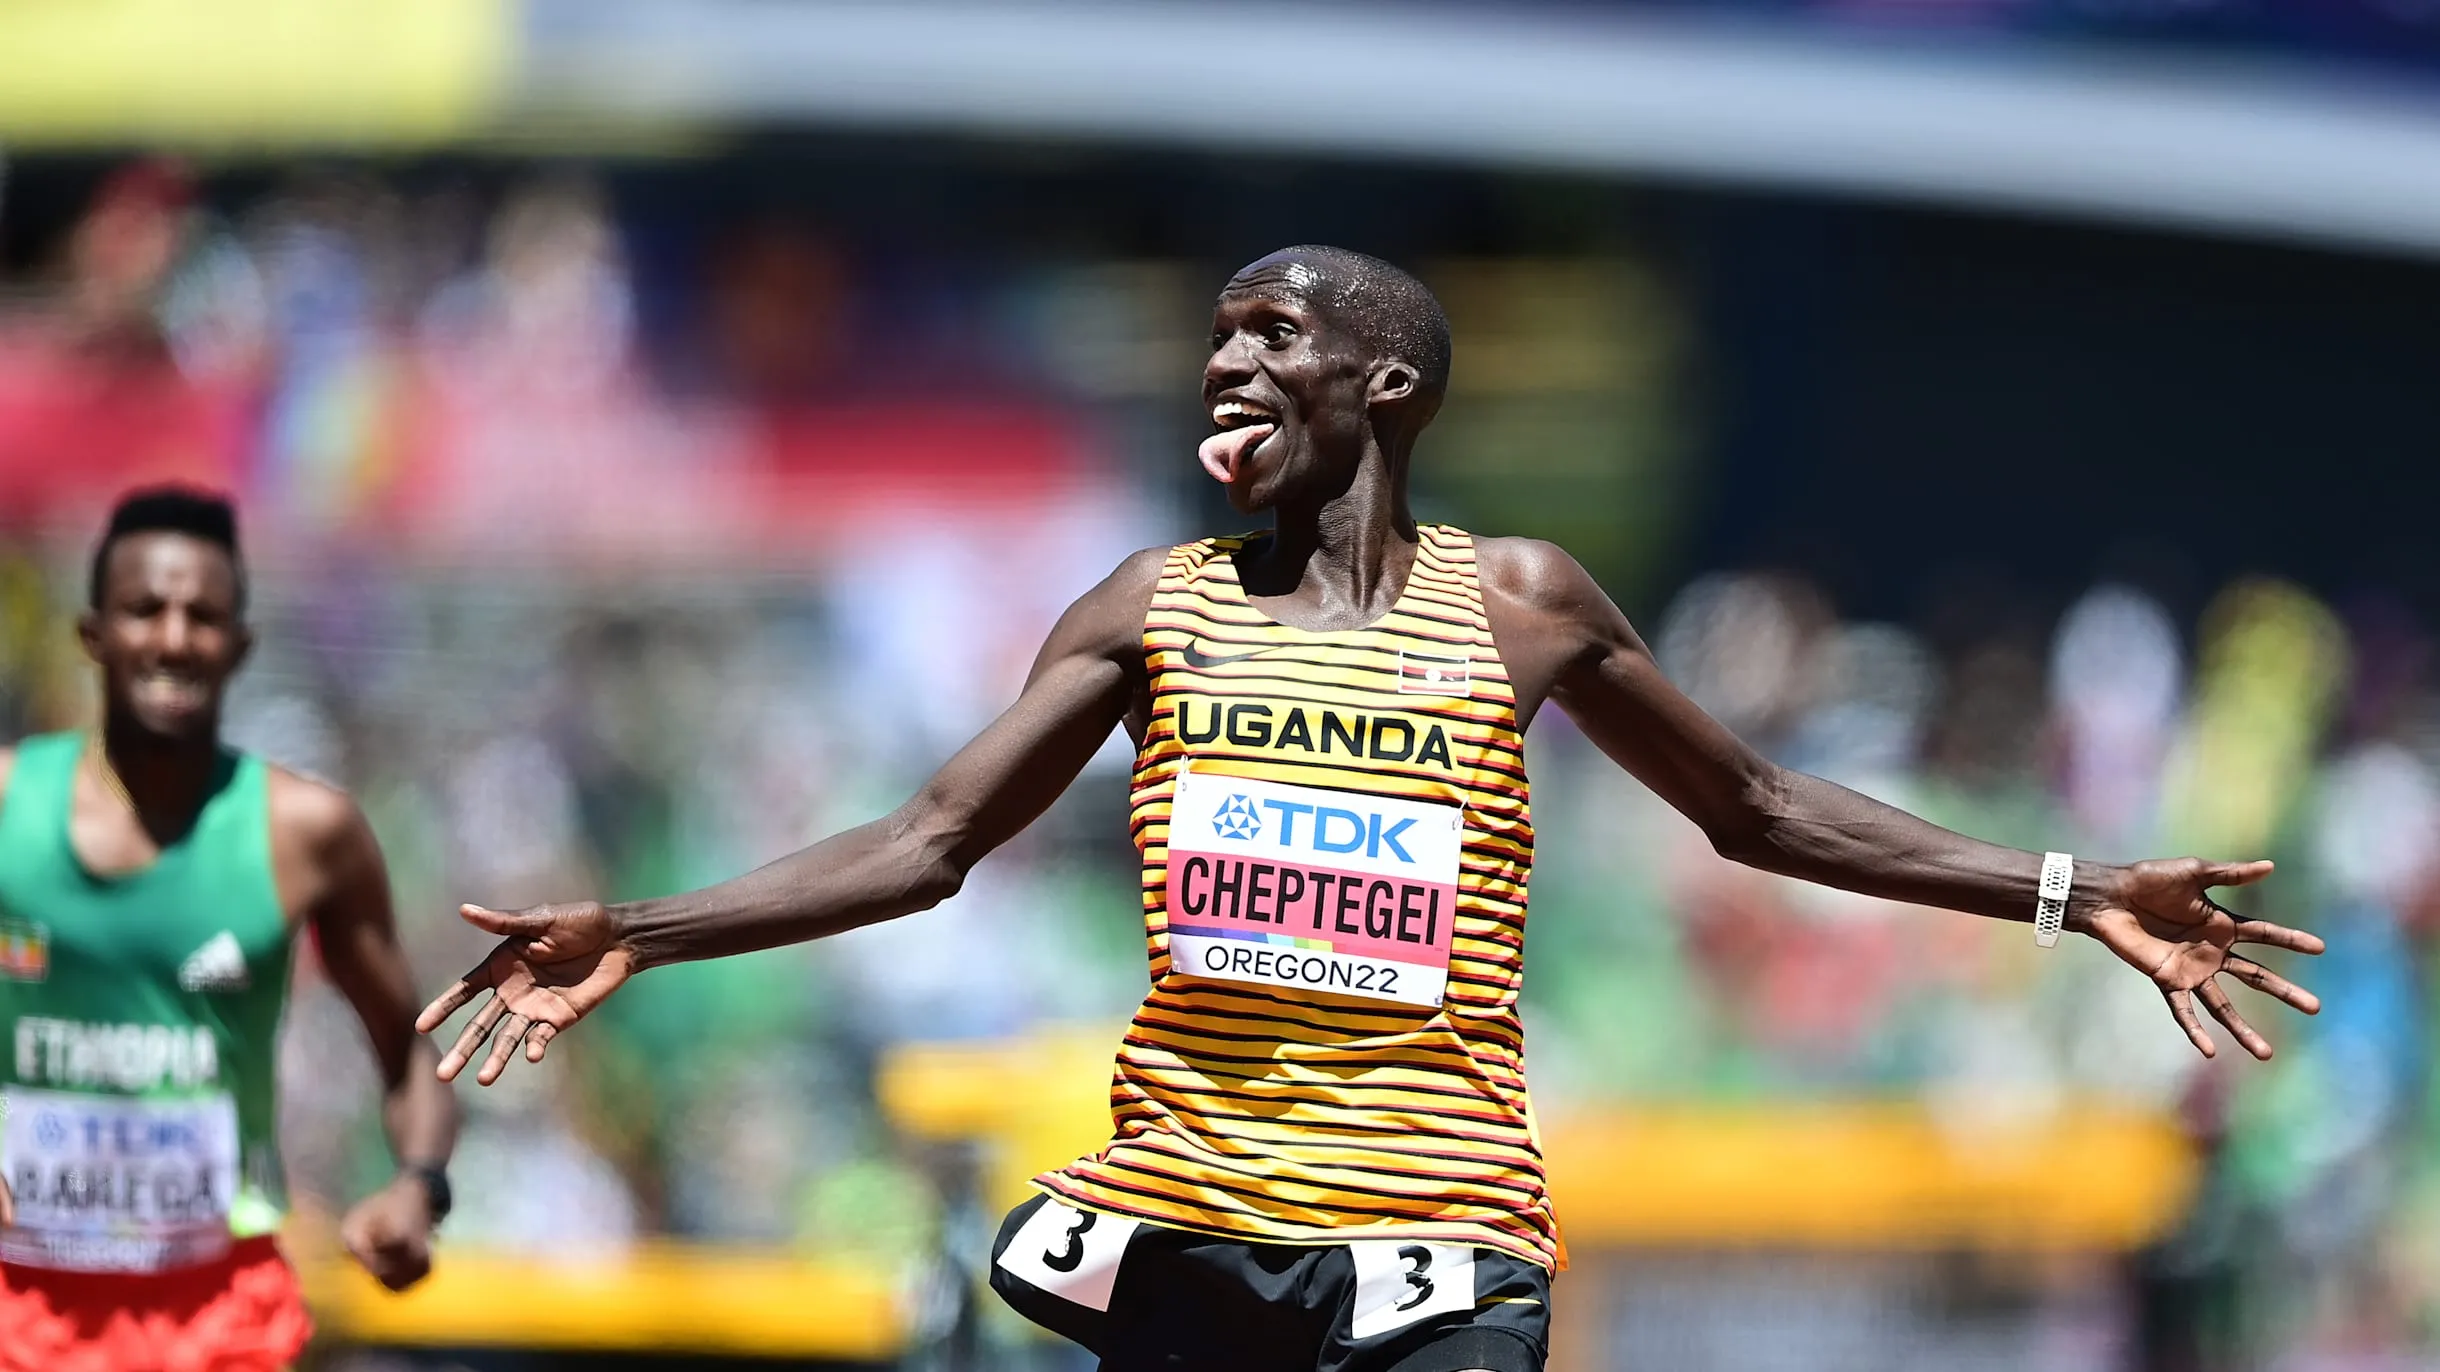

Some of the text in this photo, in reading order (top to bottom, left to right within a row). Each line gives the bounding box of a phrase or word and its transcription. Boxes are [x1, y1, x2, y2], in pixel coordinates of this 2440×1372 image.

[1178, 701, 1452, 769] UGANDA
[1263, 798, 1418, 863] TDK
[1180, 857, 1440, 945] CHEPTEGEI
[1205, 945, 1399, 994] OREGON22
[14, 1017, 219, 1085] ETHIOPIA
[1042, 1209, 1096, 1272] 3
[1395, 1245, 1434, 1312] 3
